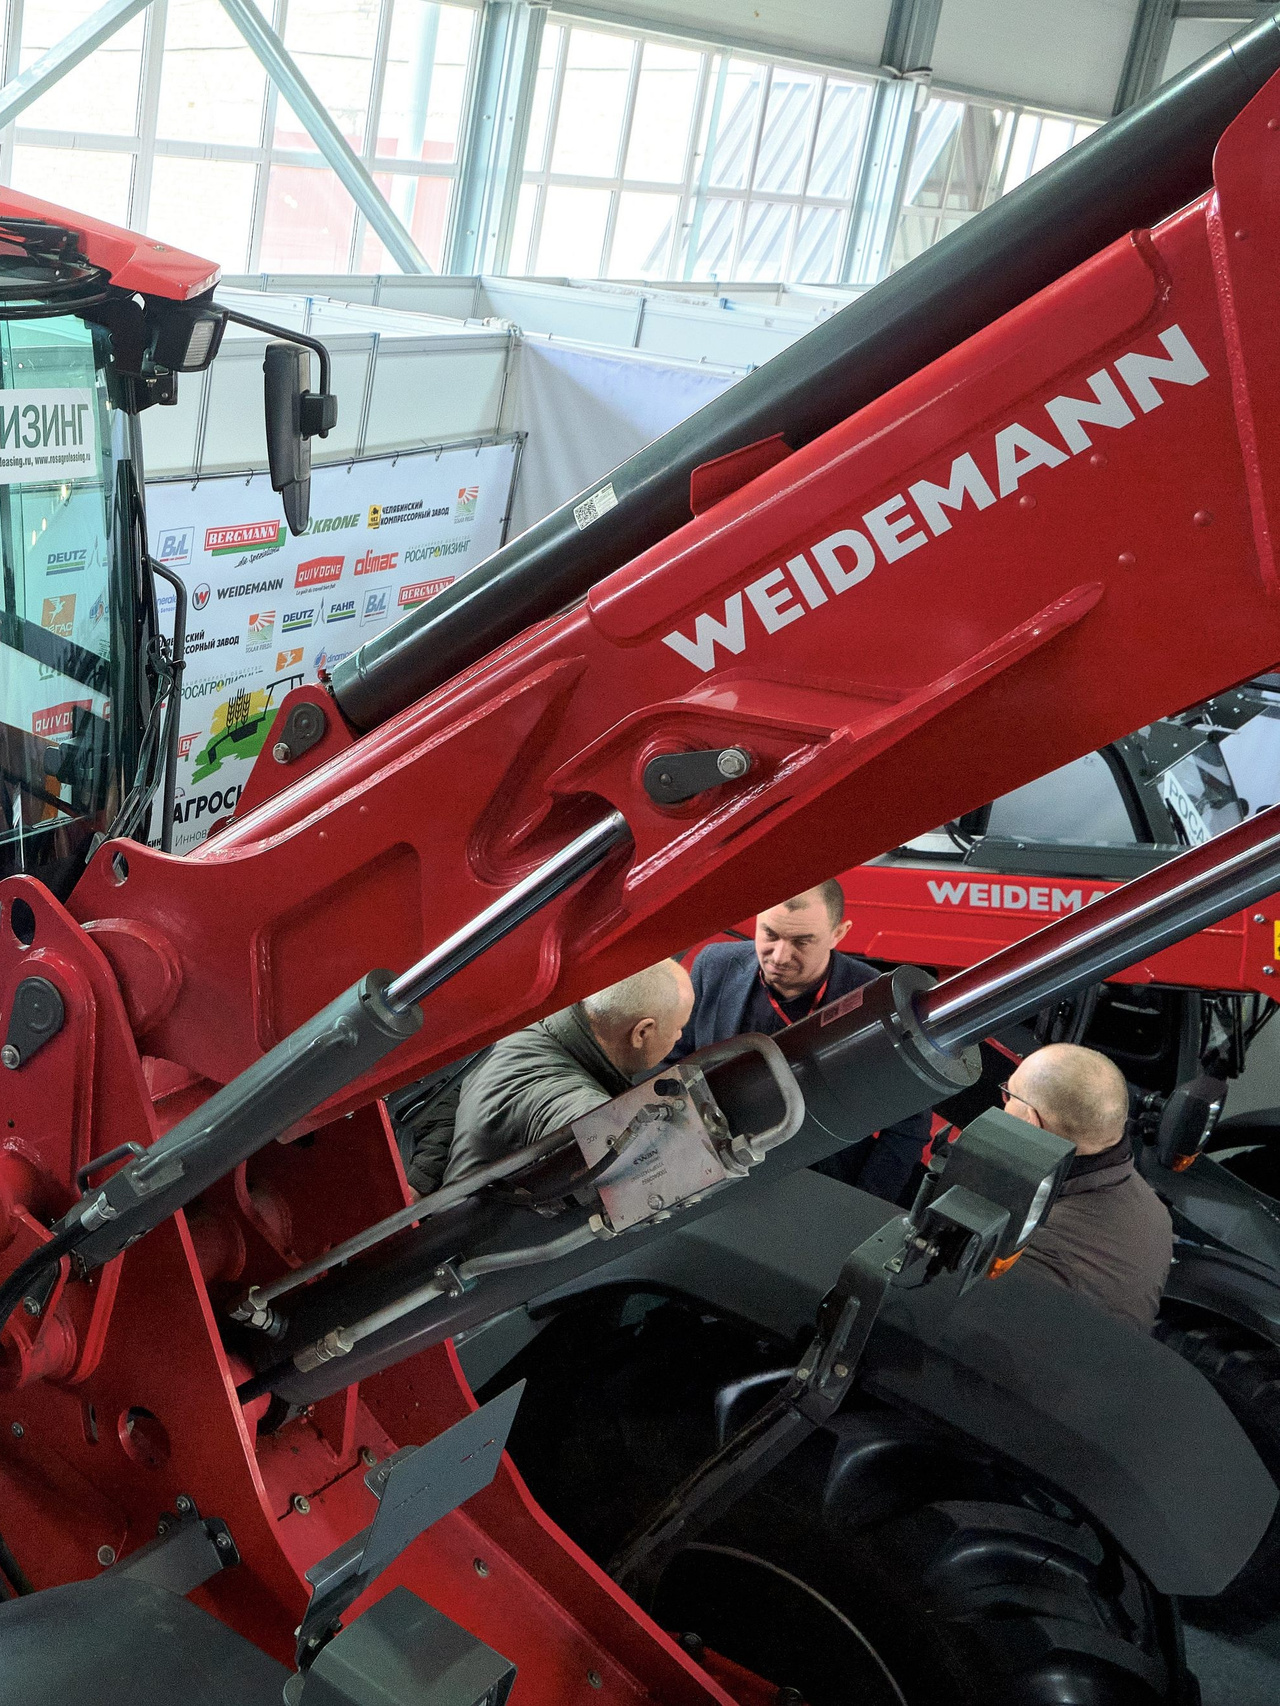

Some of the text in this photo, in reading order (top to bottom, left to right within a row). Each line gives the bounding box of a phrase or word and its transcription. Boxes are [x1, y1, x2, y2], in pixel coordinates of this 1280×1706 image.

[662, 324, 1209, 673] WEIDEMANN
[431, 506, 450, 517] ЗАВОД
[312, 513, 361, 535] KRONE
[208, 525, 276, 545] BERGMANN
[48, 549, 87, 564] DEUTZ
[298, 564, 342, 582] QUIVOGNE
[217, 578, 284, 600] WEIDEMANN
[283, 601, 355, 623] DEUTZ FAHR
[48, 622, 72, 633] ЕГАС
[216, 635, 239, 648] ЗАВОД
[927, 880, 1106, 912] WEIDEM
